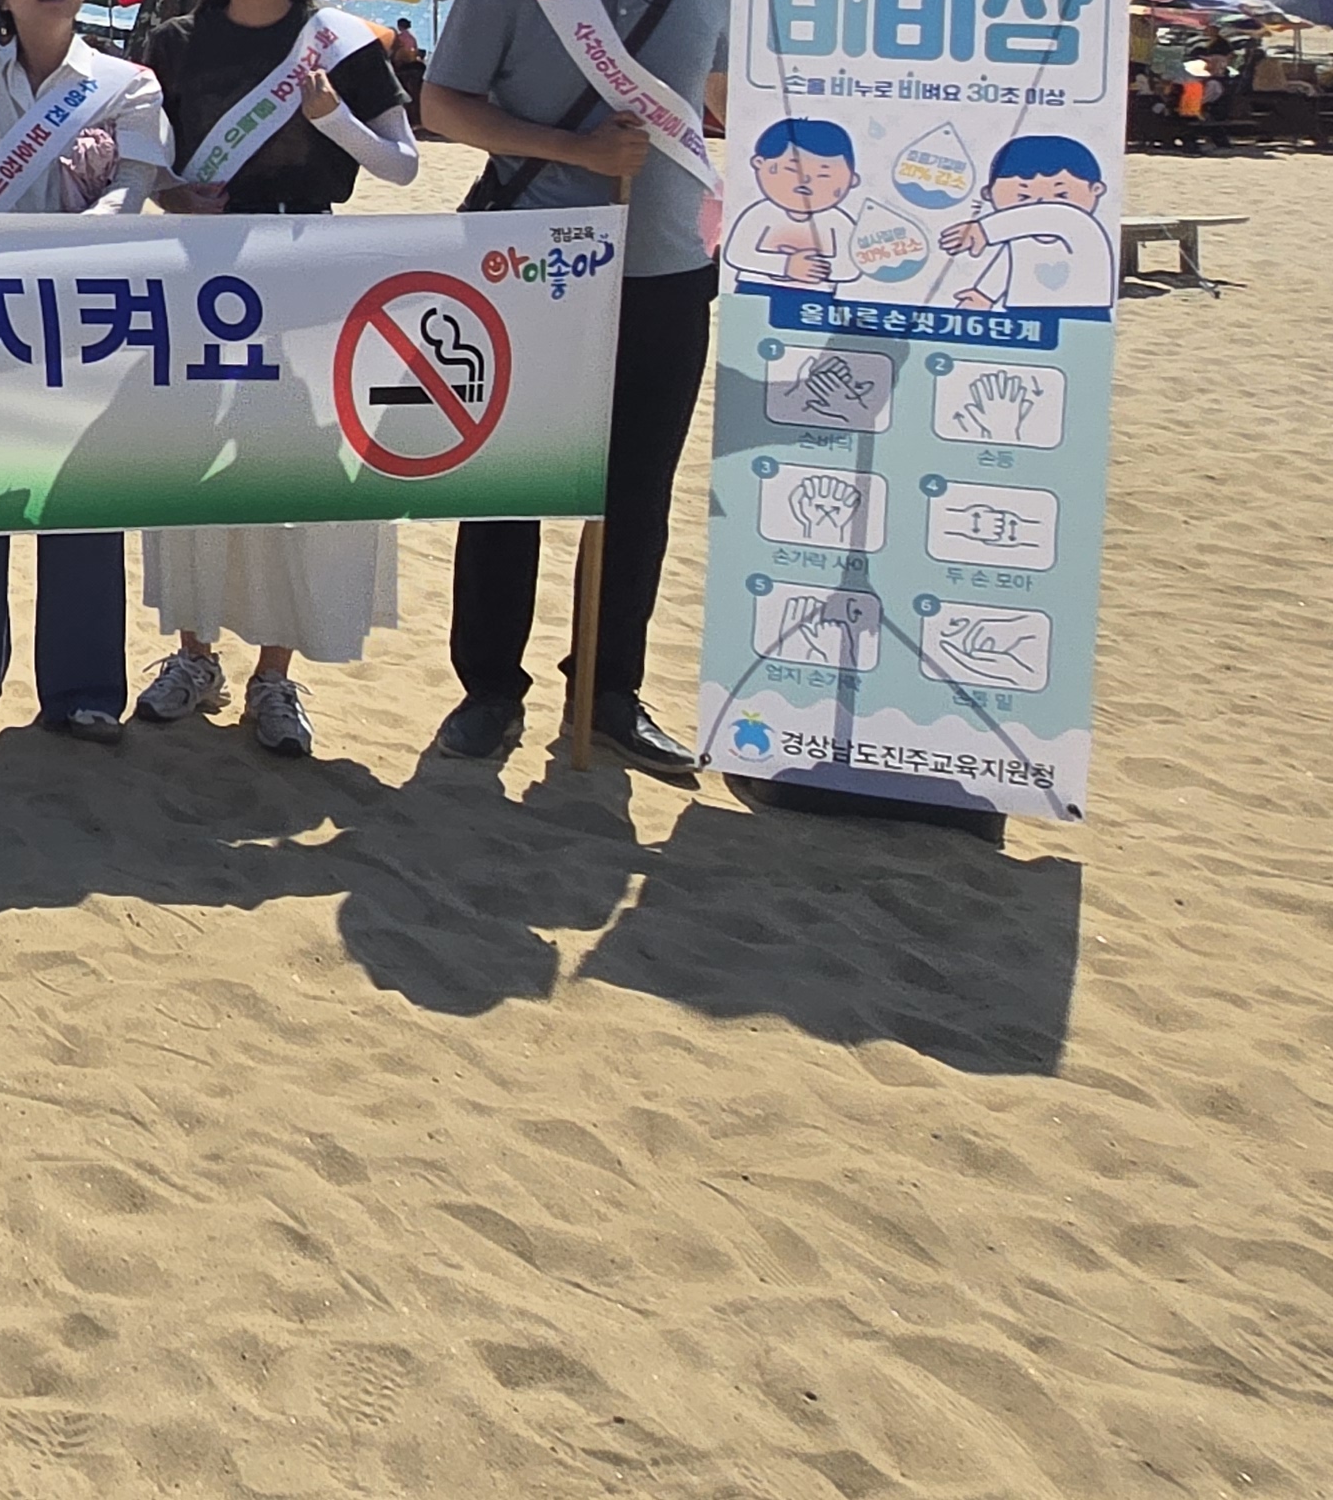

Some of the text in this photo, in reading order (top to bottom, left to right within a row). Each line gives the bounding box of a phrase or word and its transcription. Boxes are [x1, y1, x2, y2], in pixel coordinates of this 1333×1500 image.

[574, 21, 638, 96] 수상안전
[64, 78, 99, 108] 수영
[784, 73, 1066, 107] 손을 비누로 비벼요 30초 이상
[44, 104, 71, 127] 전
[224, 98, 277, 149] 물놀이
[899, 162, 967, 190] 20% 감소
[550, 226, 595, 243] 경남교육
[856, 238, 924, 264] 30% 감소
[481, 240, 614, 300] 아이좋아
[772, 549, 869, 575] 손가락 사이
[946, 567, 1033, 592] 두 손 모아
[765, 664, 801, 685] 엄지
[780, 730, 1055, 790] 경상남도진주교육지원청
